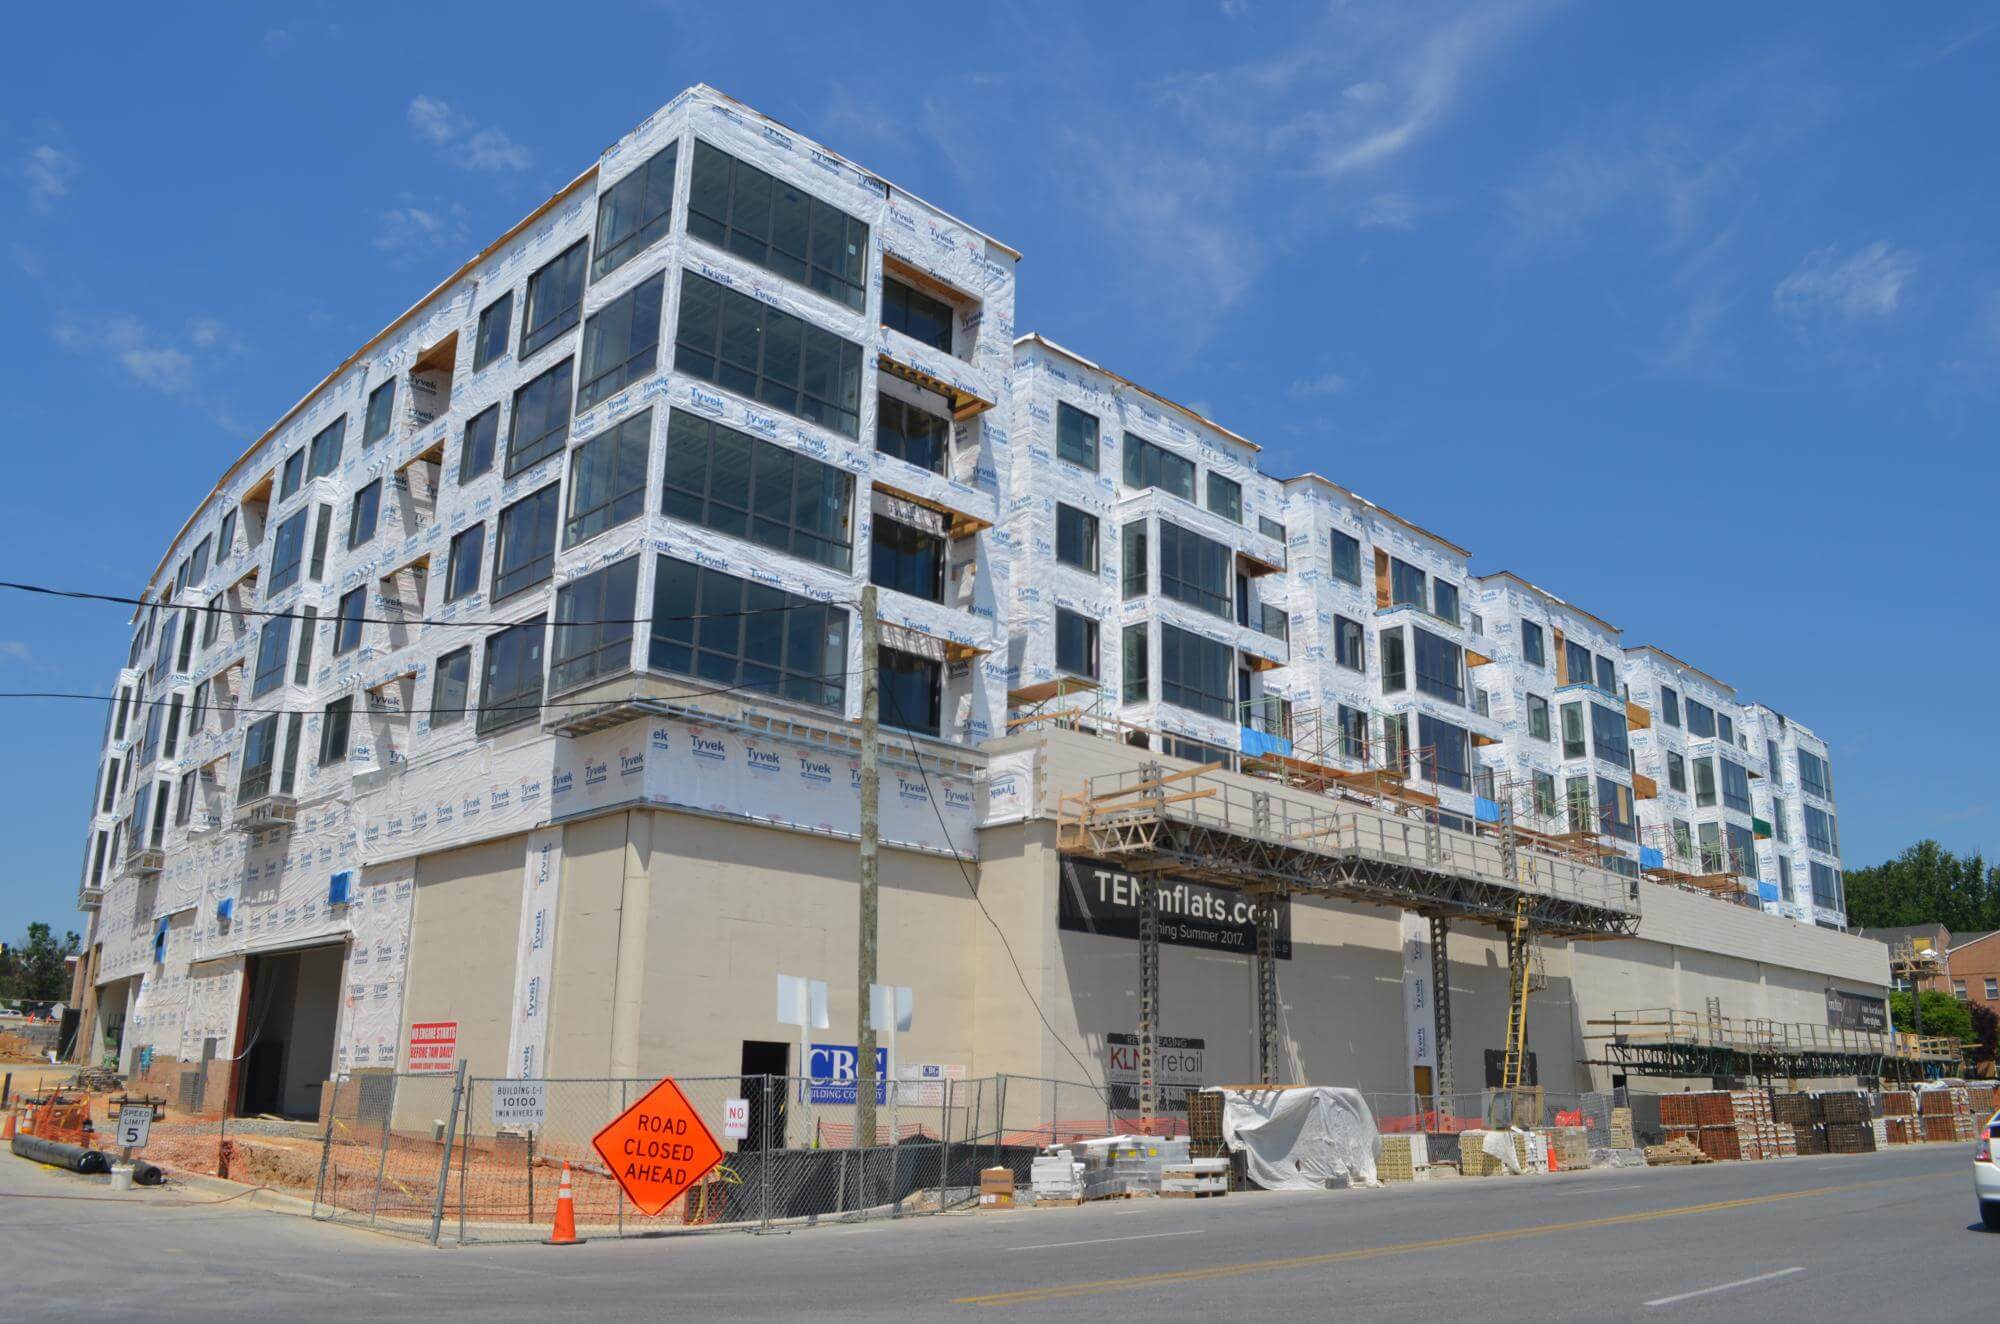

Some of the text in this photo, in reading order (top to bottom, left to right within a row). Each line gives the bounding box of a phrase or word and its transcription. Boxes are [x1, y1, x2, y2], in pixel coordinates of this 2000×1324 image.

[889, 207, 916, 226] Tyvek
[929, 228, 956, 246] Tyvek
[754, 287, 778, 304] Tyve
[961, 310, 984, 328] Tyvek
[909, 358, 937, 377] Tyvek
[410, 375, 437, 389] Tyvek
[642, 375, 670, 394] Tyvek
[953, 377, 979, 396] Tyvek
[607, 392, 630, 410] Tyvek
[690, 386, 725, 409] Tyvek
[574, 412, 595, 429] Tyvek
[745, 408, 778, 430] Tyvek
[983, 419, 1008, 438] Tyvek
[797, 430, 828, 451] Tyvek
[845, 450, 871, 468] Tyve
[972, 466, 998, 478] Tyvek
[474, 495, 492, 510] Tyvek
[602, 548, 626, 564] Tyvek
[695, 550, 730, 570] Tyvek
[567, 562, 591, 579] Tyvek
[750, 568, 784, 586] Tyvek
[802, 584, 833, 602] Tyvek
[375, 595, 403, 608] Tyvek
[967, 604, 993, 617] Tyvek
[903, 617, 931, 634] Tyvek
[948, 630, 976, 647] Tyvek
[371, 693, 400, 706] Tyvek
[963, 719, 988, 731] Tyvek
[690, 735, 725, 752] Tyvek
[620, 753, 644, 769] Tyvek
[746, 746, 780, 764] Tyvek
[585, 762, 608, 779] Tyvek
[800, 758, 831, 775] Tyvek
[520, 780, 542, 795] Tyvek
[552, 772, 573, 787] Tyvek
[899, 779, 928, 795] Tyvek
[491, 788, 511, 803] Tyvek
[944, 788, 971, 802] Tyvek
[436, 805, 453, 819] Tyvek
[463, 797, 481, 811] Tyvek
[387, 818, 403, 832] Tyvek
[411, 811, 428, 825] Tyvek
[365, 825, 379, 838] Tyvek
[539, 842, 553, 886] Tyvek
[372, 886, 387, 897] Tyvek
[396, 882, 411, 893] Tyvek
[533, 909, 544, 952] Tyvek
[1180, 924, 1219, 942] Summer
[1220, 930, 1245, 946] 2017.
[354, 949, 369, 959] Tyvek
[377, 945, 392, 955] Tyvek
[527, 976, 538, 1018] Tyvek
[355, 1045, 370, 1056] Tyvek
[378, 1044, 394, 1055] Tyvek
[1159, 1038, 1188, 1048] EASING
[1110, 1047, 1203, 1073] KLN retail
[497, 1086, 530, 1096] BUILDING
[812, 1089, 841, 1099] ILDING
[503, 1097, 536, 1107] 10100
[124, 1110, 150, 1118] SPEED
[512, 1109, 533, 1117] RIVERS
[729, 1107, 744, 1120] NO
[638, 1114, 687, 1136] ROAD
[125, 1127, 139, 1143] 5
[624, 1138, 694, 1162] CLOSED
[624, 1162, 687, 1186] AHEAD
